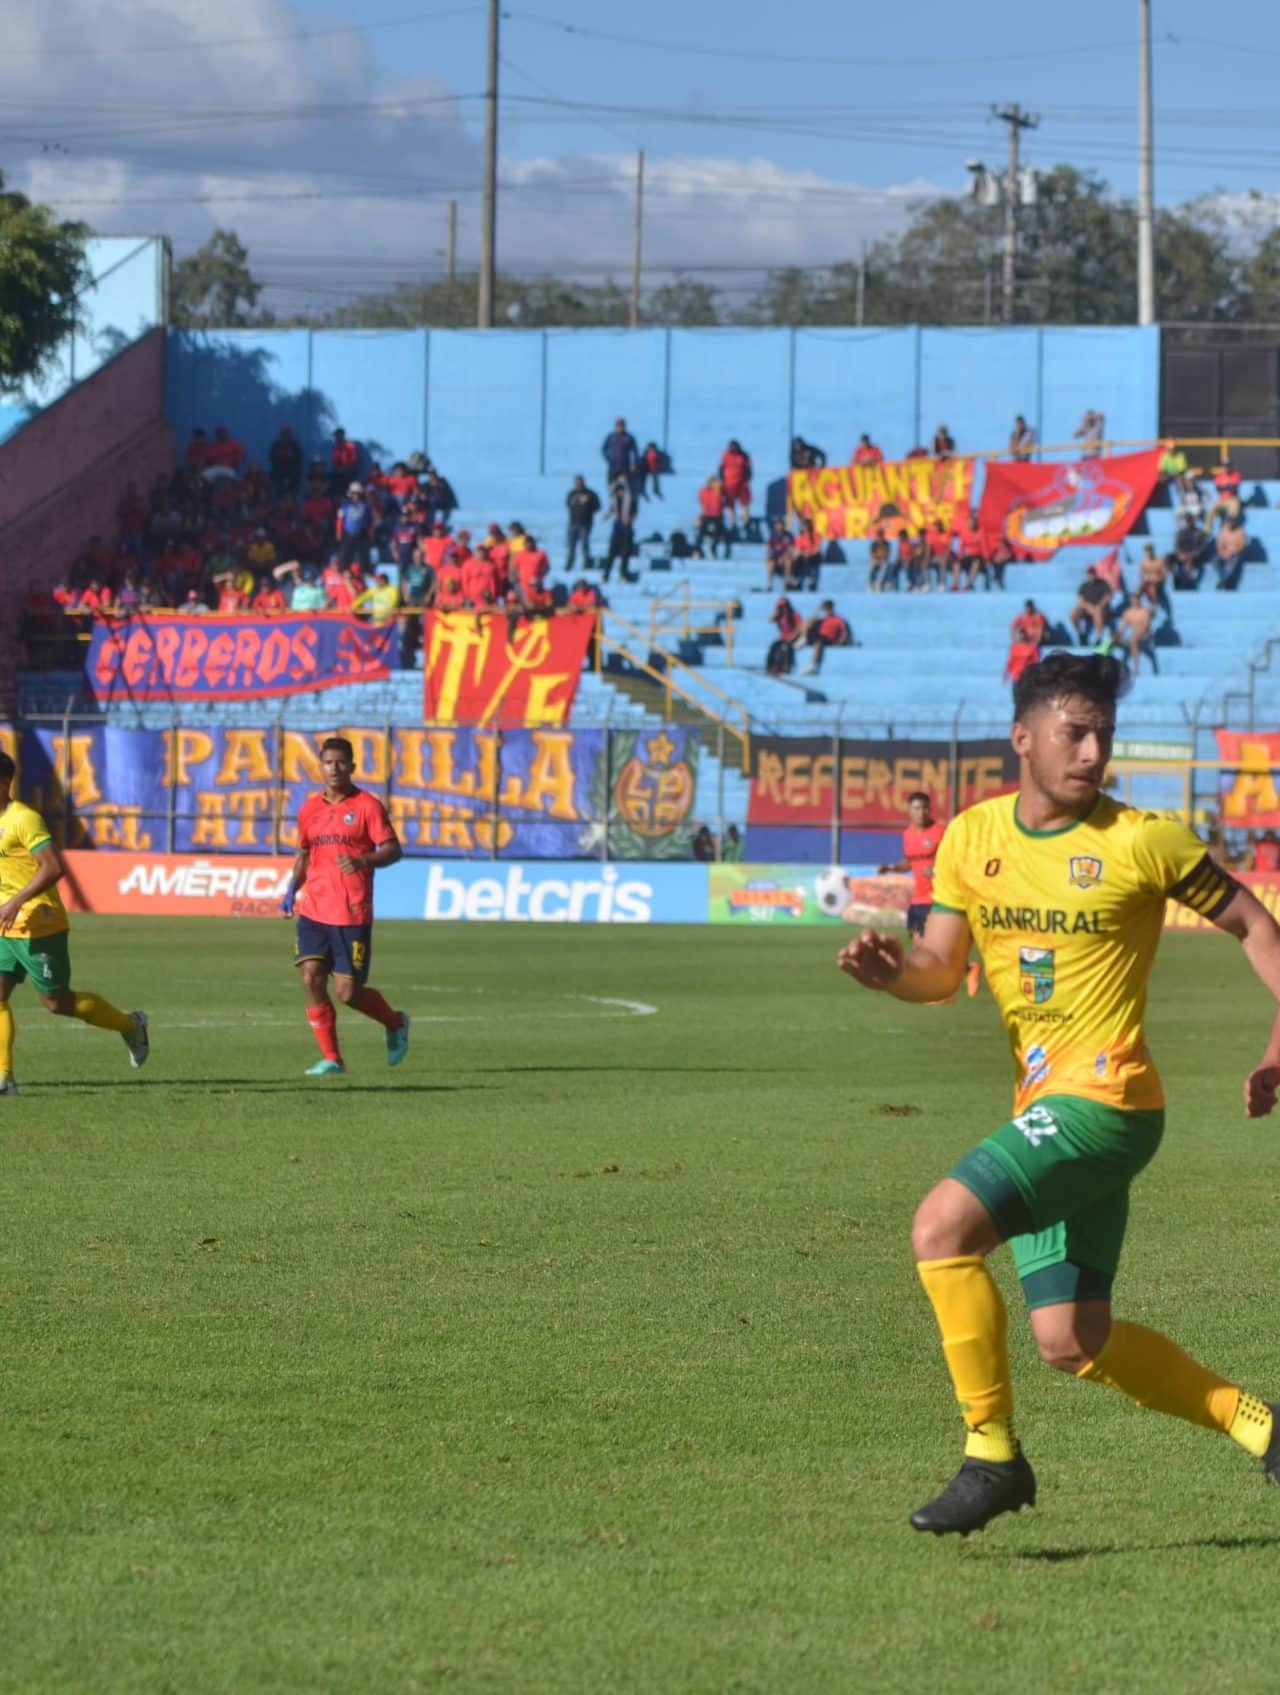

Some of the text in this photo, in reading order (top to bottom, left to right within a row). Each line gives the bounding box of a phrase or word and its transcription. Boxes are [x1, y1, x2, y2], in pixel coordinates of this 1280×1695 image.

[95, 624, 318, 688] CERBEROS
[162, 727, 579, 820] PANDILLA
[757, 750, 1004, 813] REFERENTE
[423, 864, 653, 923] betcris
[979, 903, 1112, 935] BANRURAL
